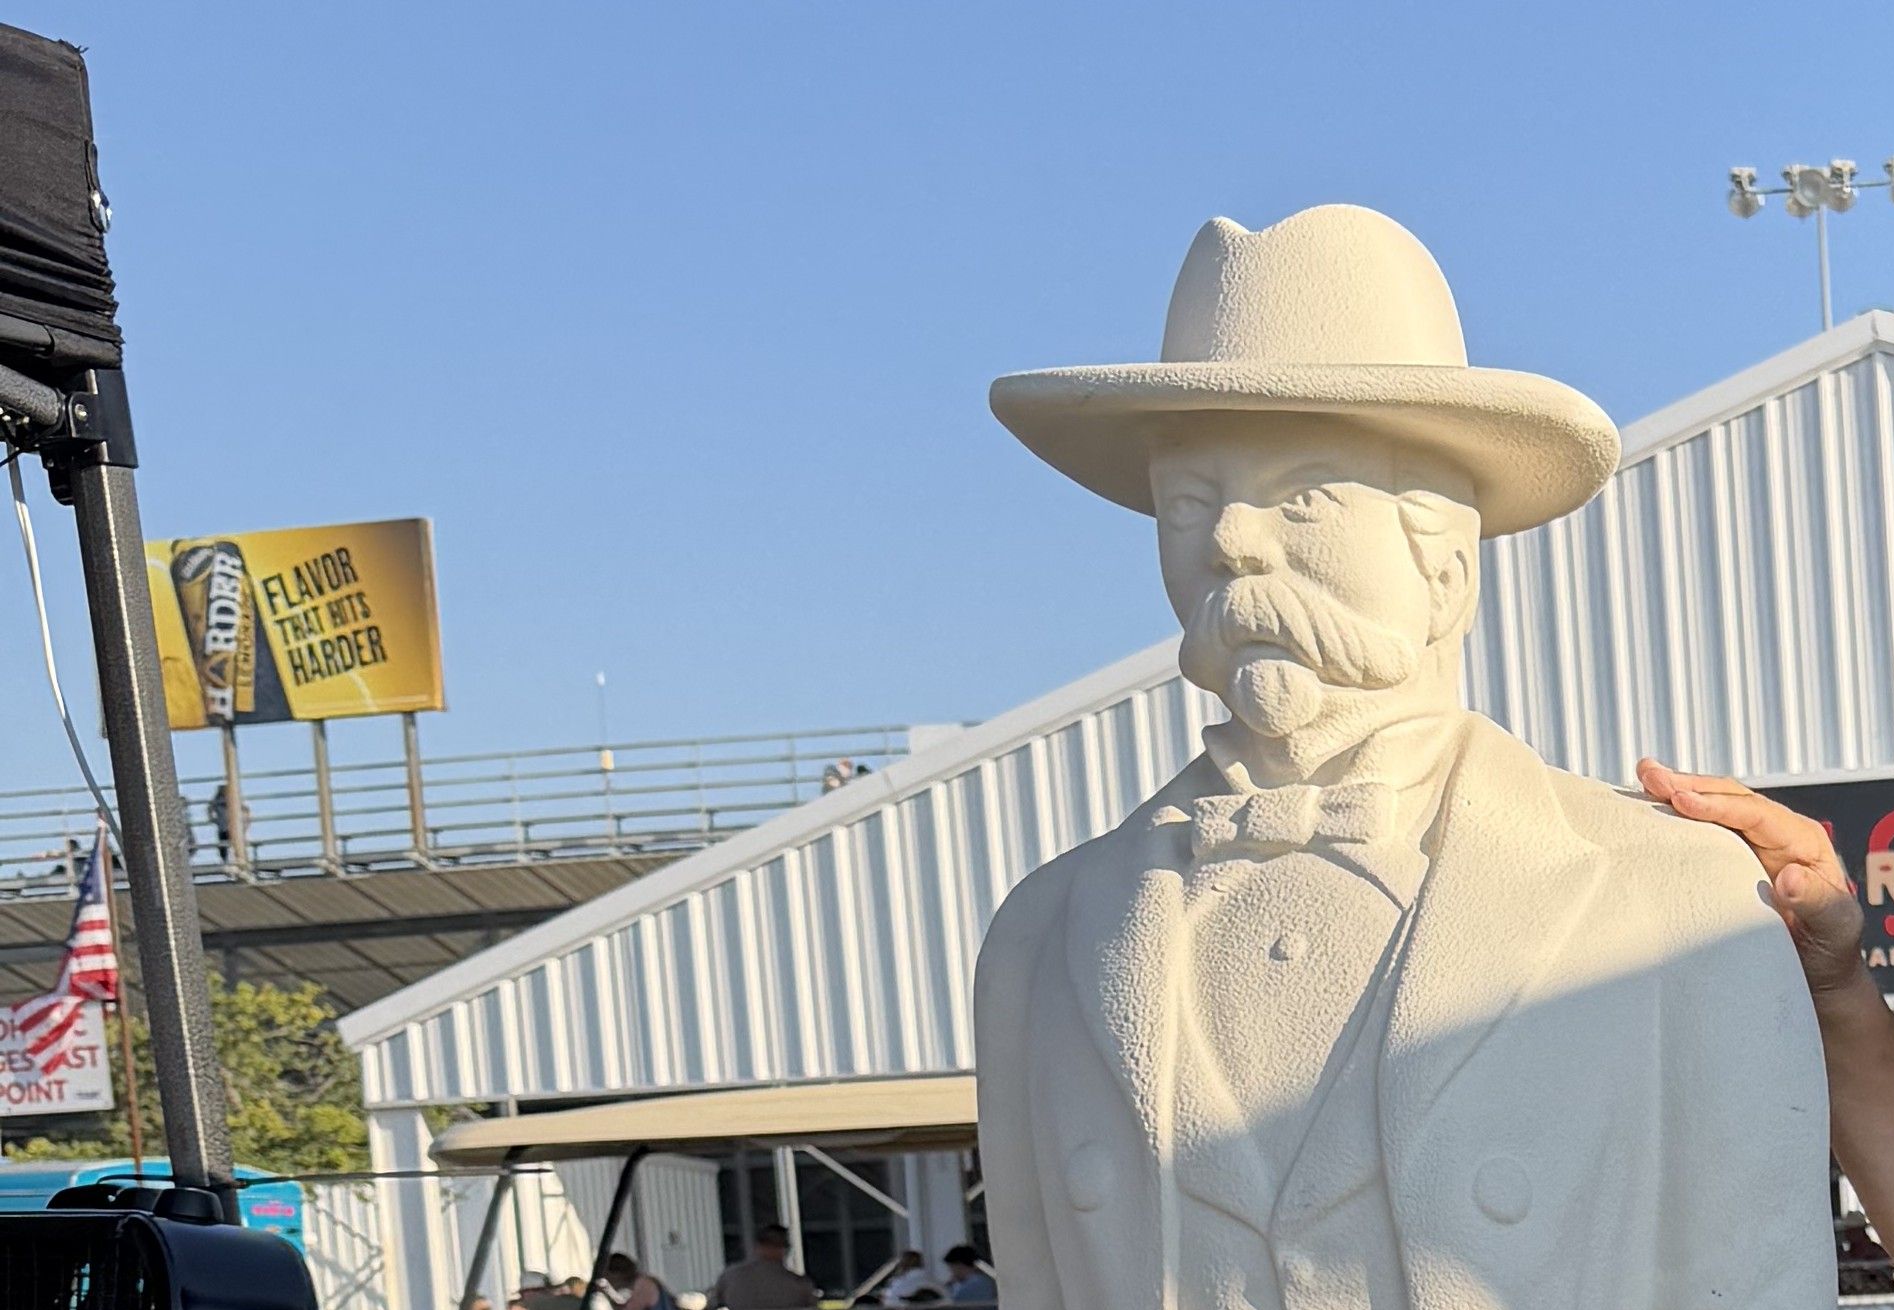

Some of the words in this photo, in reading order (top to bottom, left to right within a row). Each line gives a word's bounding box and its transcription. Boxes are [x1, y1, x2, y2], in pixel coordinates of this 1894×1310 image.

[262, 547, 359, 614] FLAVOR
[272, 605, 325, 647] THAT
[288, 625, 389, 687] HARDER
